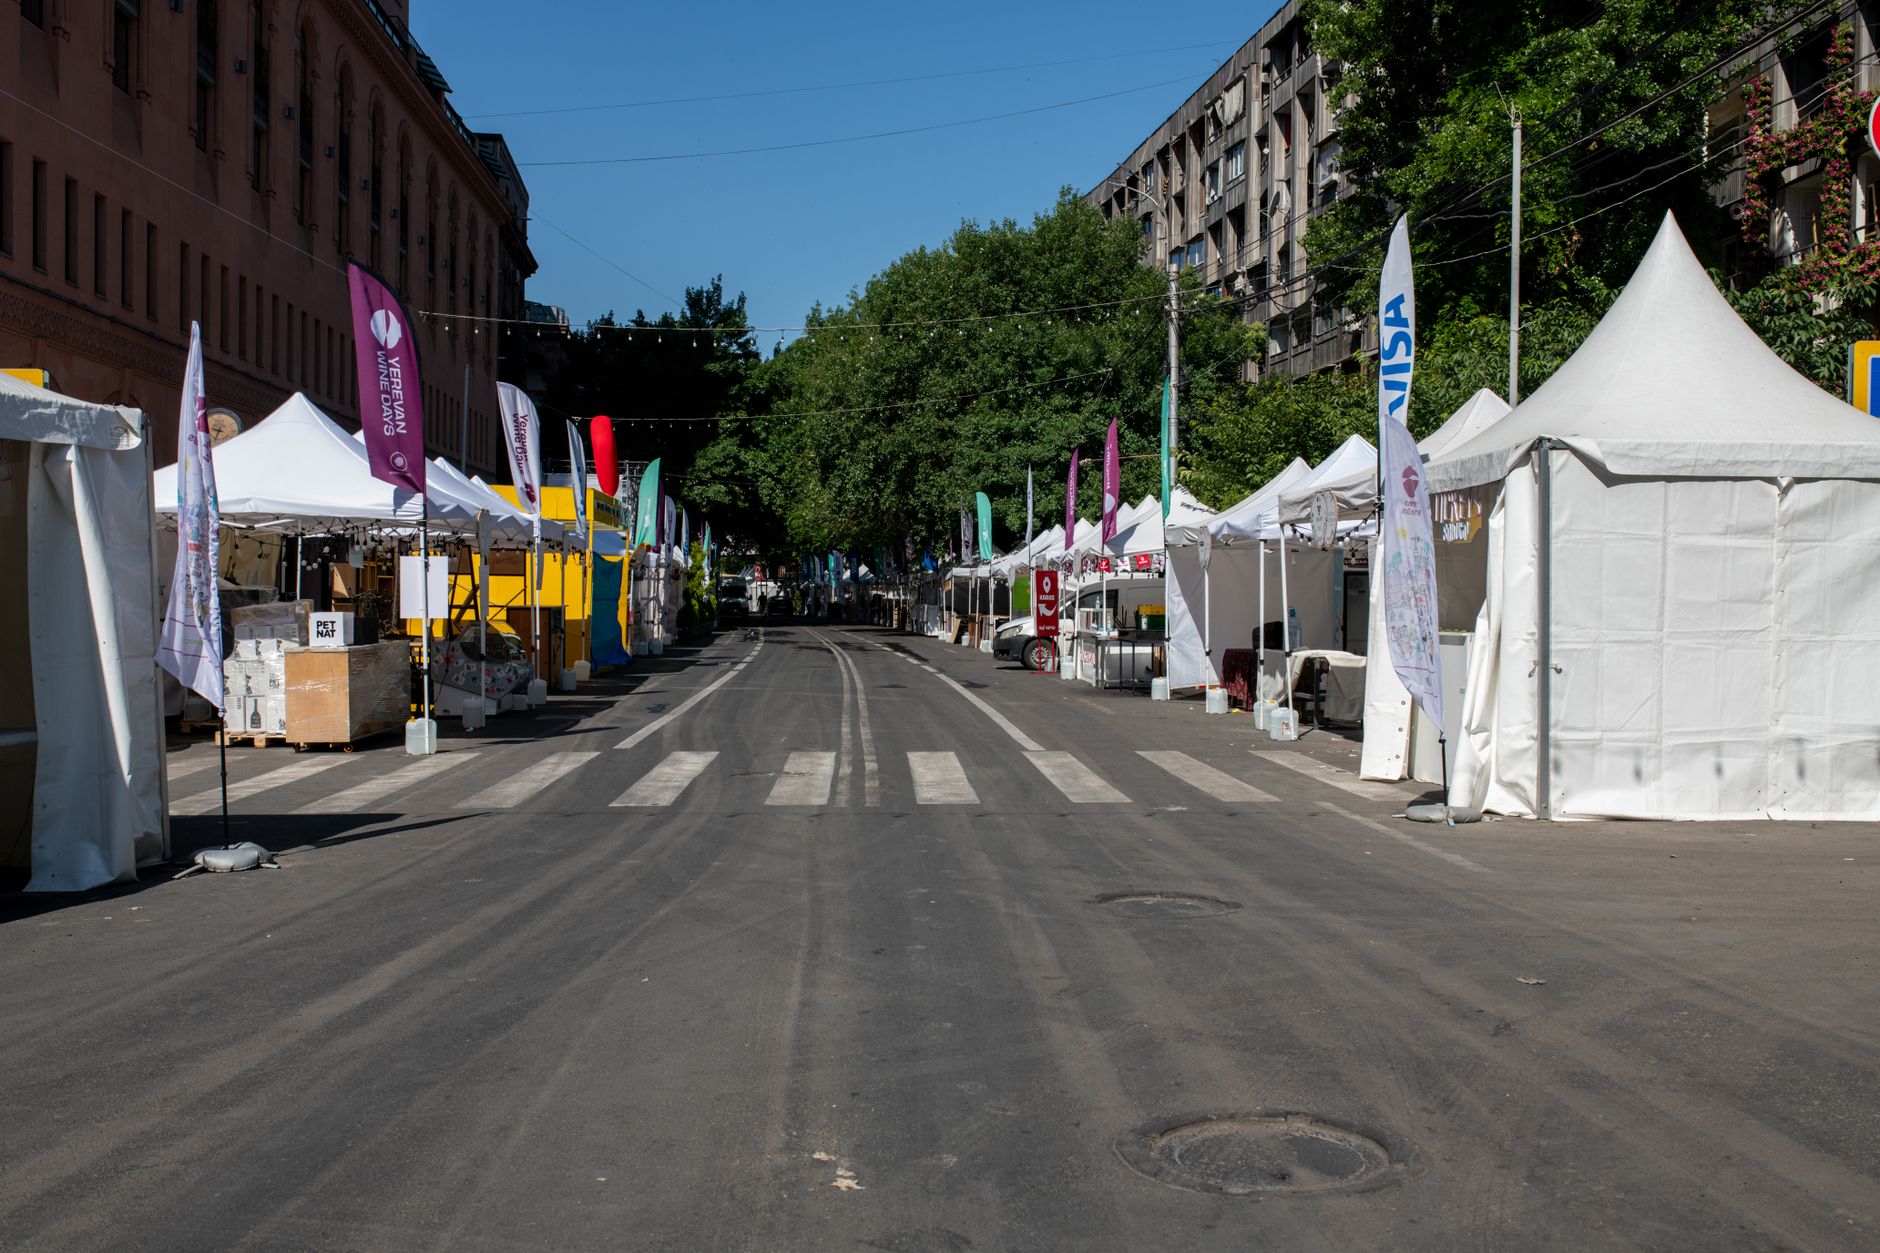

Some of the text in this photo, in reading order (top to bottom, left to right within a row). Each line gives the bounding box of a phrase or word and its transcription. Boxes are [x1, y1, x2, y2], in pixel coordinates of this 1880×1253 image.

[376, 350, 395, 437] WINE DAYS
[1381, 293, 1412, 416] VISA
[388, 356, 407, 434] YEREVAN
[316, 620, 336, 630] PET
[316, 629, 336, 638] NAT
